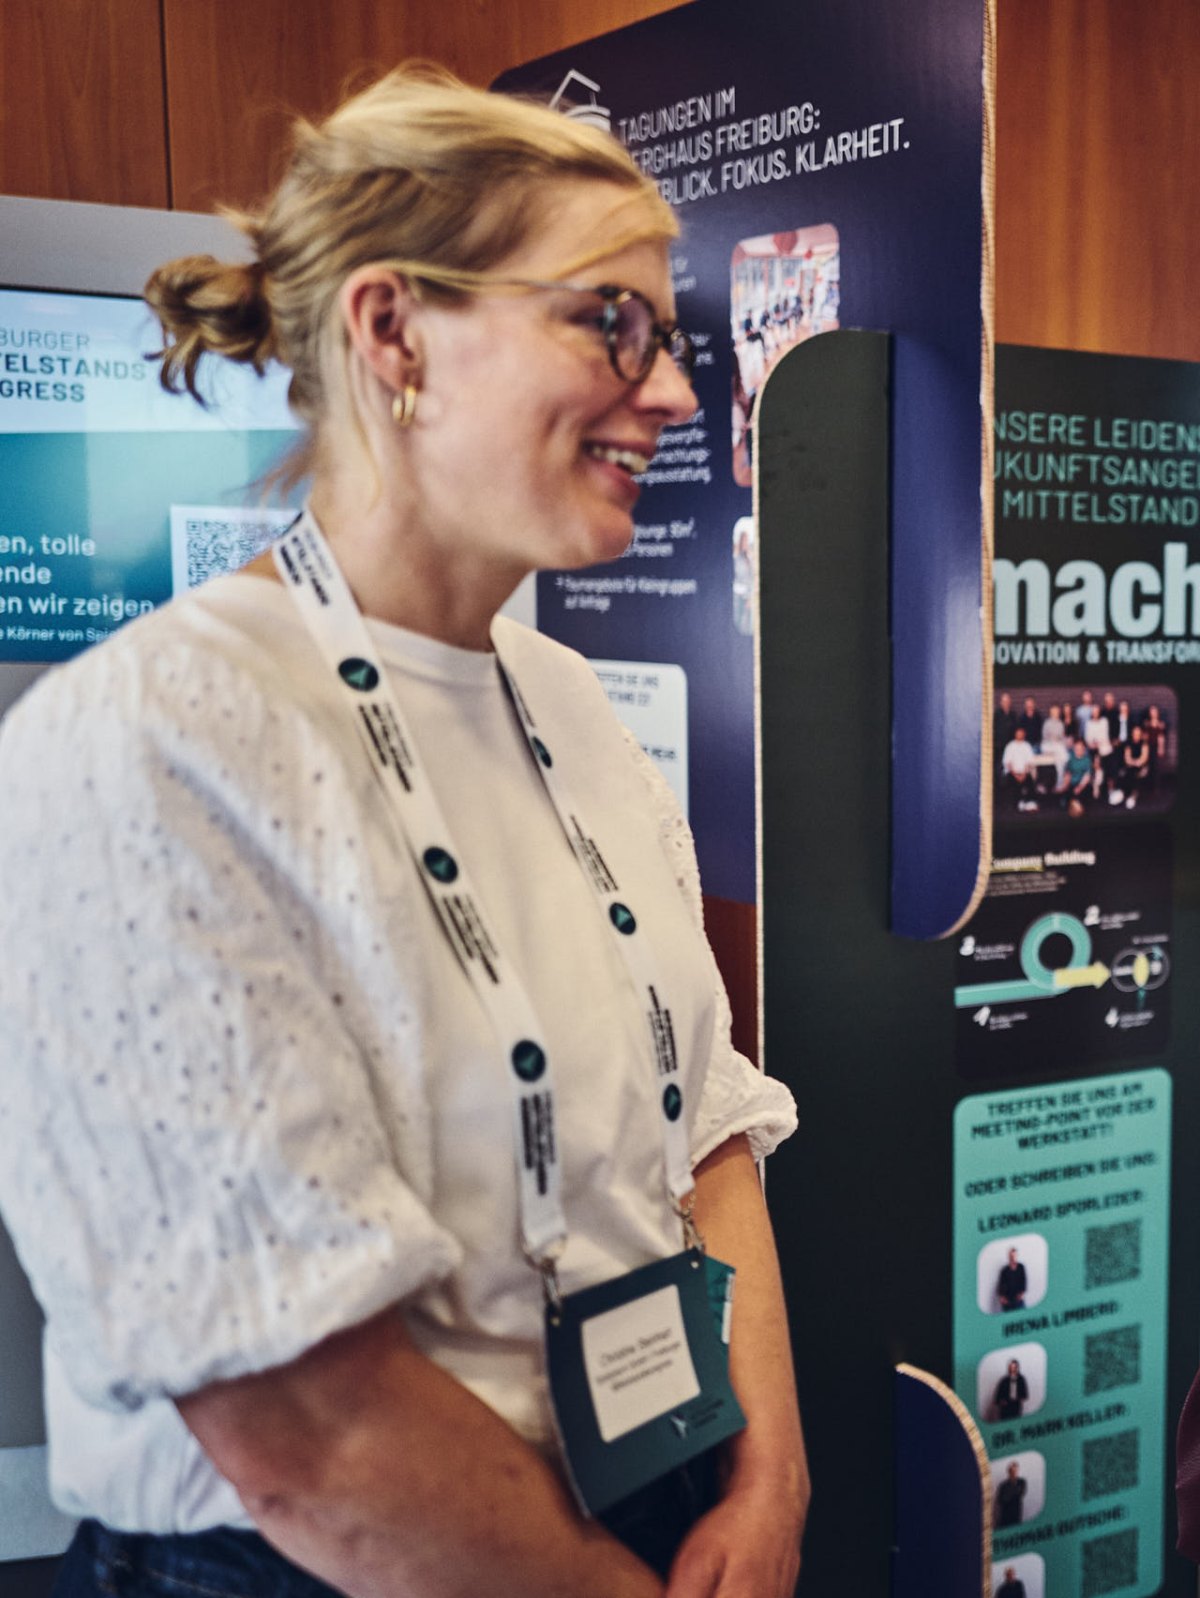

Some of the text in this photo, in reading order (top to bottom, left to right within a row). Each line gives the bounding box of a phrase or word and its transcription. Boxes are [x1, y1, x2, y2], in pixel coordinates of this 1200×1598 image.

[618, 86, 737, 146] TAGUNGEN IM
[715, 102, 821, 157] FREIBURG:
[656, 118, 910, 205] BLICK. FOKUS. KLARHEIT.
[0, 352, 147, 381] ELSTANDS
[0, 379, 86, 402] GRESS
[1003, 489, 1199, 526] MITTELSTAND
[40, 533, 96, 557] tolle
[28, 592, 68, 615] wir
[72, 593, 154, 621] zeigen
[994, 640, 1080, 665] OVATION
[1086, 640, 1100, 665] &
